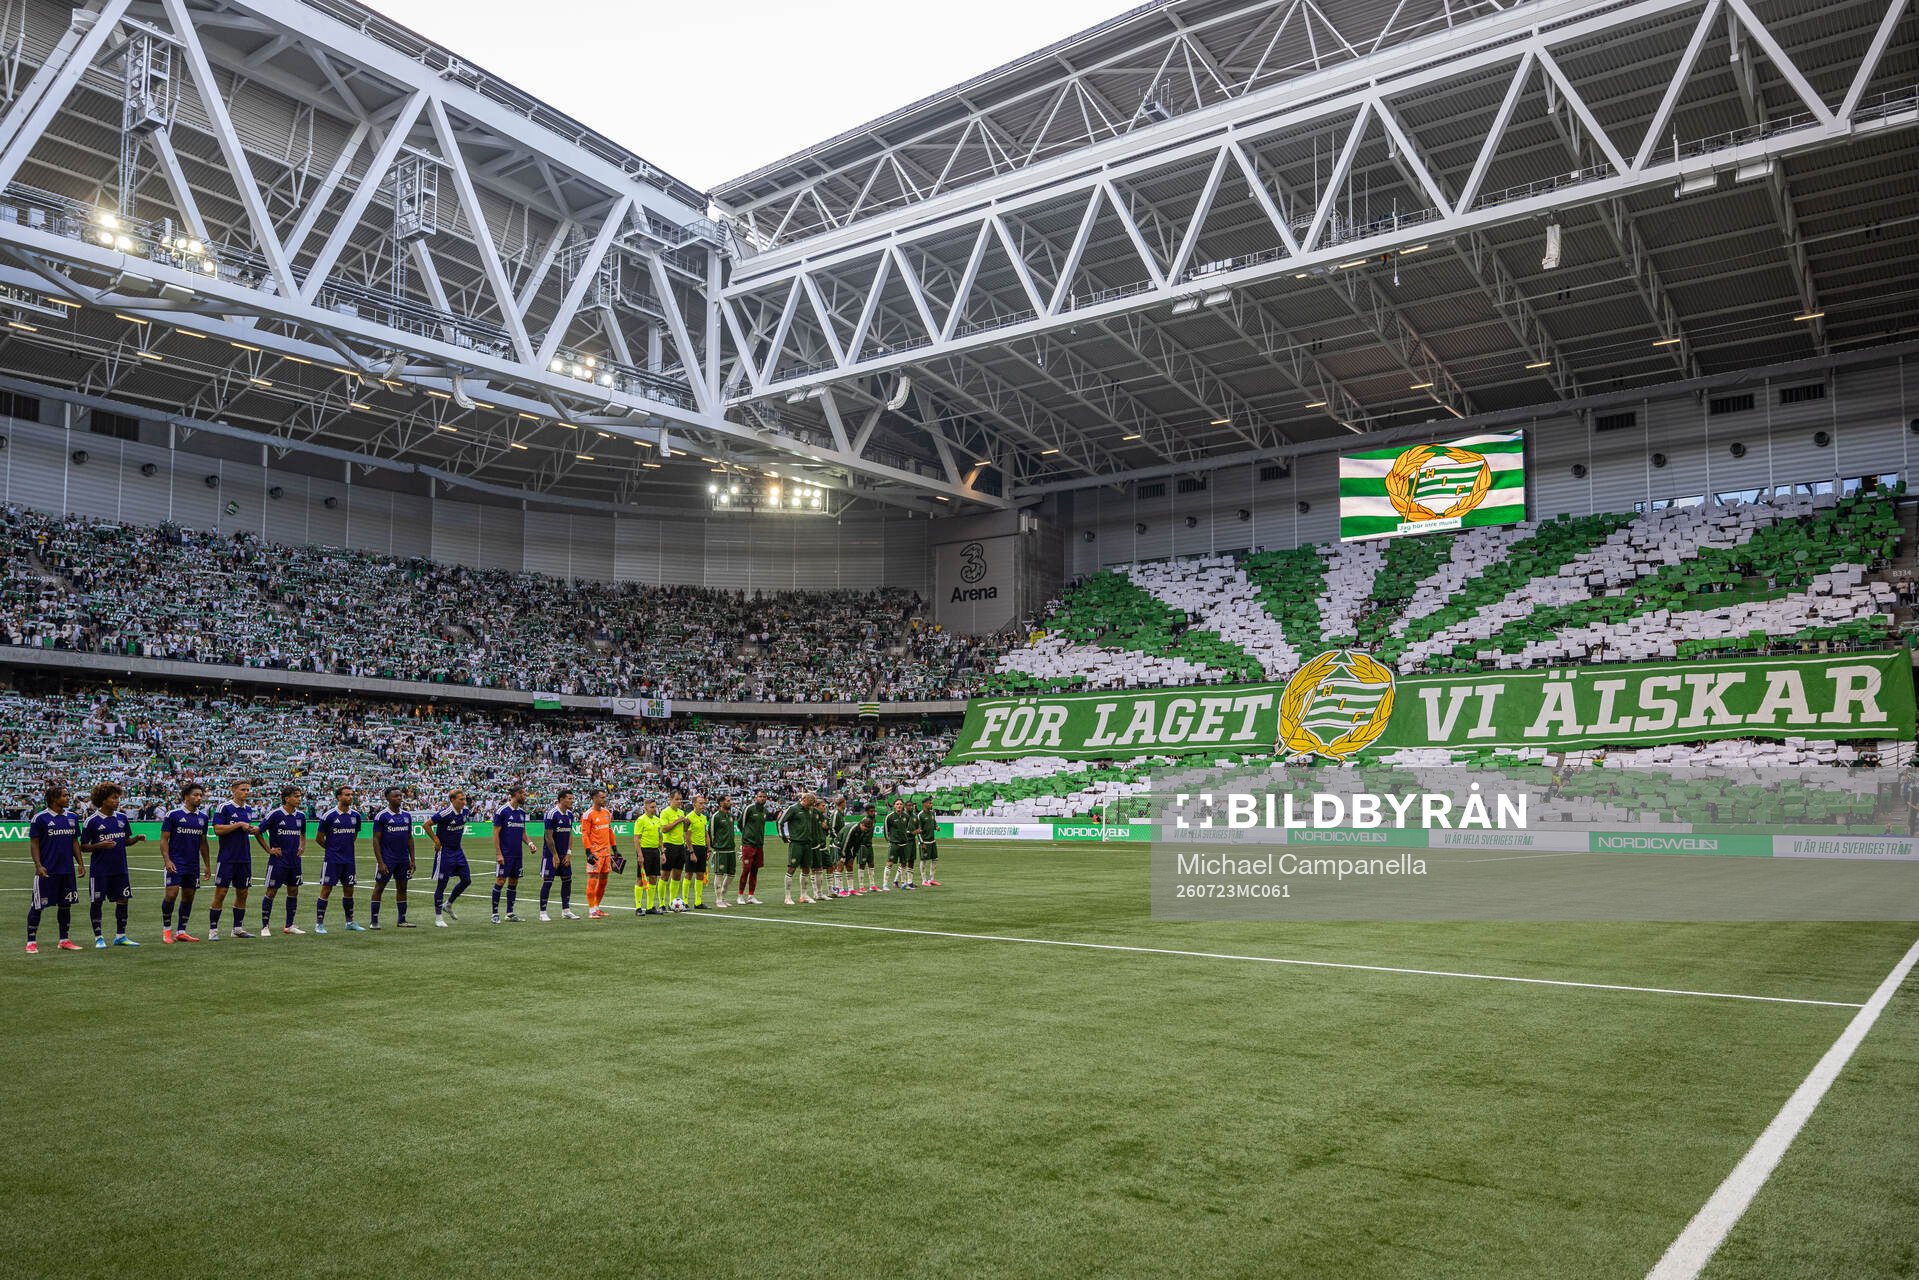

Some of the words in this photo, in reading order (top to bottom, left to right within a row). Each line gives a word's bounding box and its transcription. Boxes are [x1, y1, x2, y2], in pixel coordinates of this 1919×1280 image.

[951, 586, 997, 603] Arena
[1419, 684, 1504, 742] VI
[1524, 665, 1887, 737] ÄLSKAR
[648, 708, 664, 716] LOVE
[972, 698, 1068, 750] FÖR
[1084, 693, 1273, 747] LAGET
[1444, 833, 1452, 844] VI
[1452, 832, 1462, 844] ÄR
[1463, 834, 1480, 845] HELA
[1481, 834, 1514, 846] SVERIGES
[1793, 840, 1802, 853] VI
[1803, 839, 1817, 853] ÄR
[1818, 841, 1840, 854] HELA
[1841, 841, 1885, 855] SVERIGES
